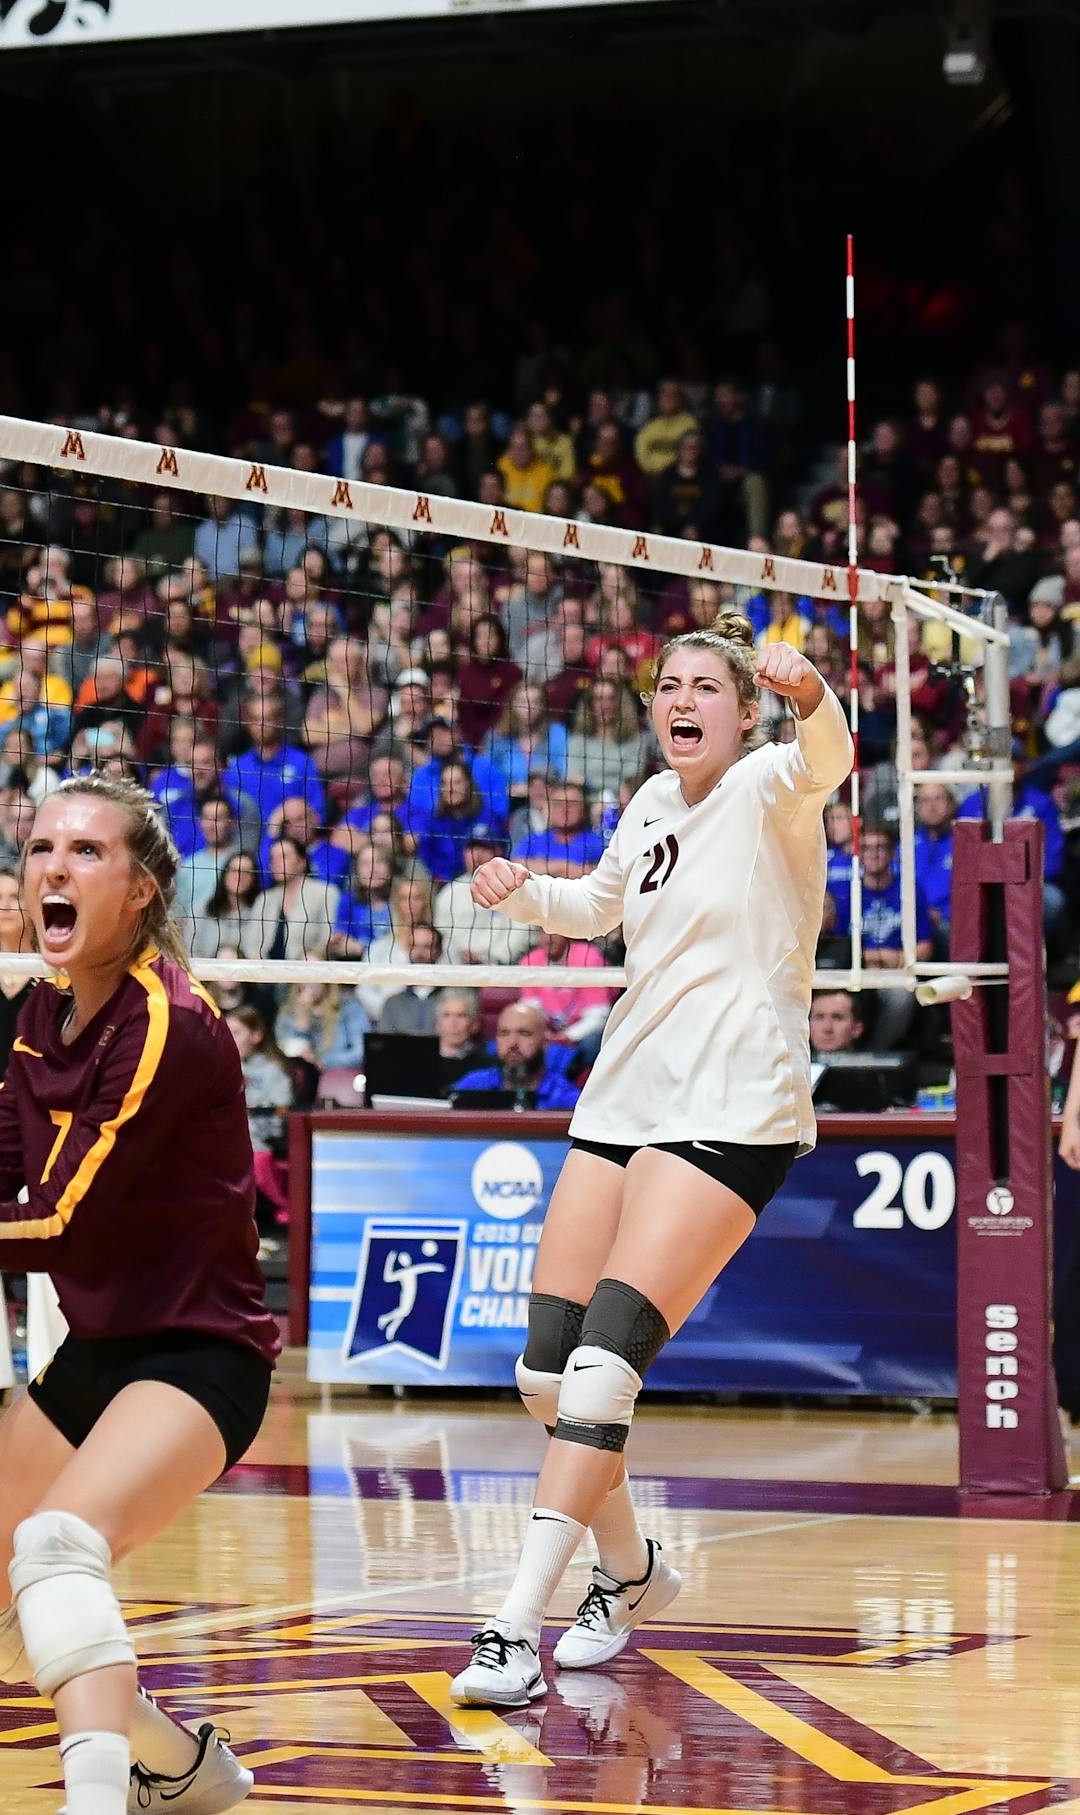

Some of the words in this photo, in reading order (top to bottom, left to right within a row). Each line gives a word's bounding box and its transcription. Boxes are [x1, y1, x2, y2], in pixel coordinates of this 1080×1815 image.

[60, 430, 85, 460] M
[156, 448, 179, 476] M
[246, 465, 267, 494] M
[331, 480, 353, 508] M
[413, 496, 432, 523] M
[490, 509, 508, 536] M
[639, 833, 680, 895] 21
[39, 1109, 74, 1185] 7
[481, 1181, 538, 1199] NCAA
[852, 1150, 957, 1231] 20
[472, 1223, 519, 1244] 2019
[984, 1303, 1019, 1429] Senoh
